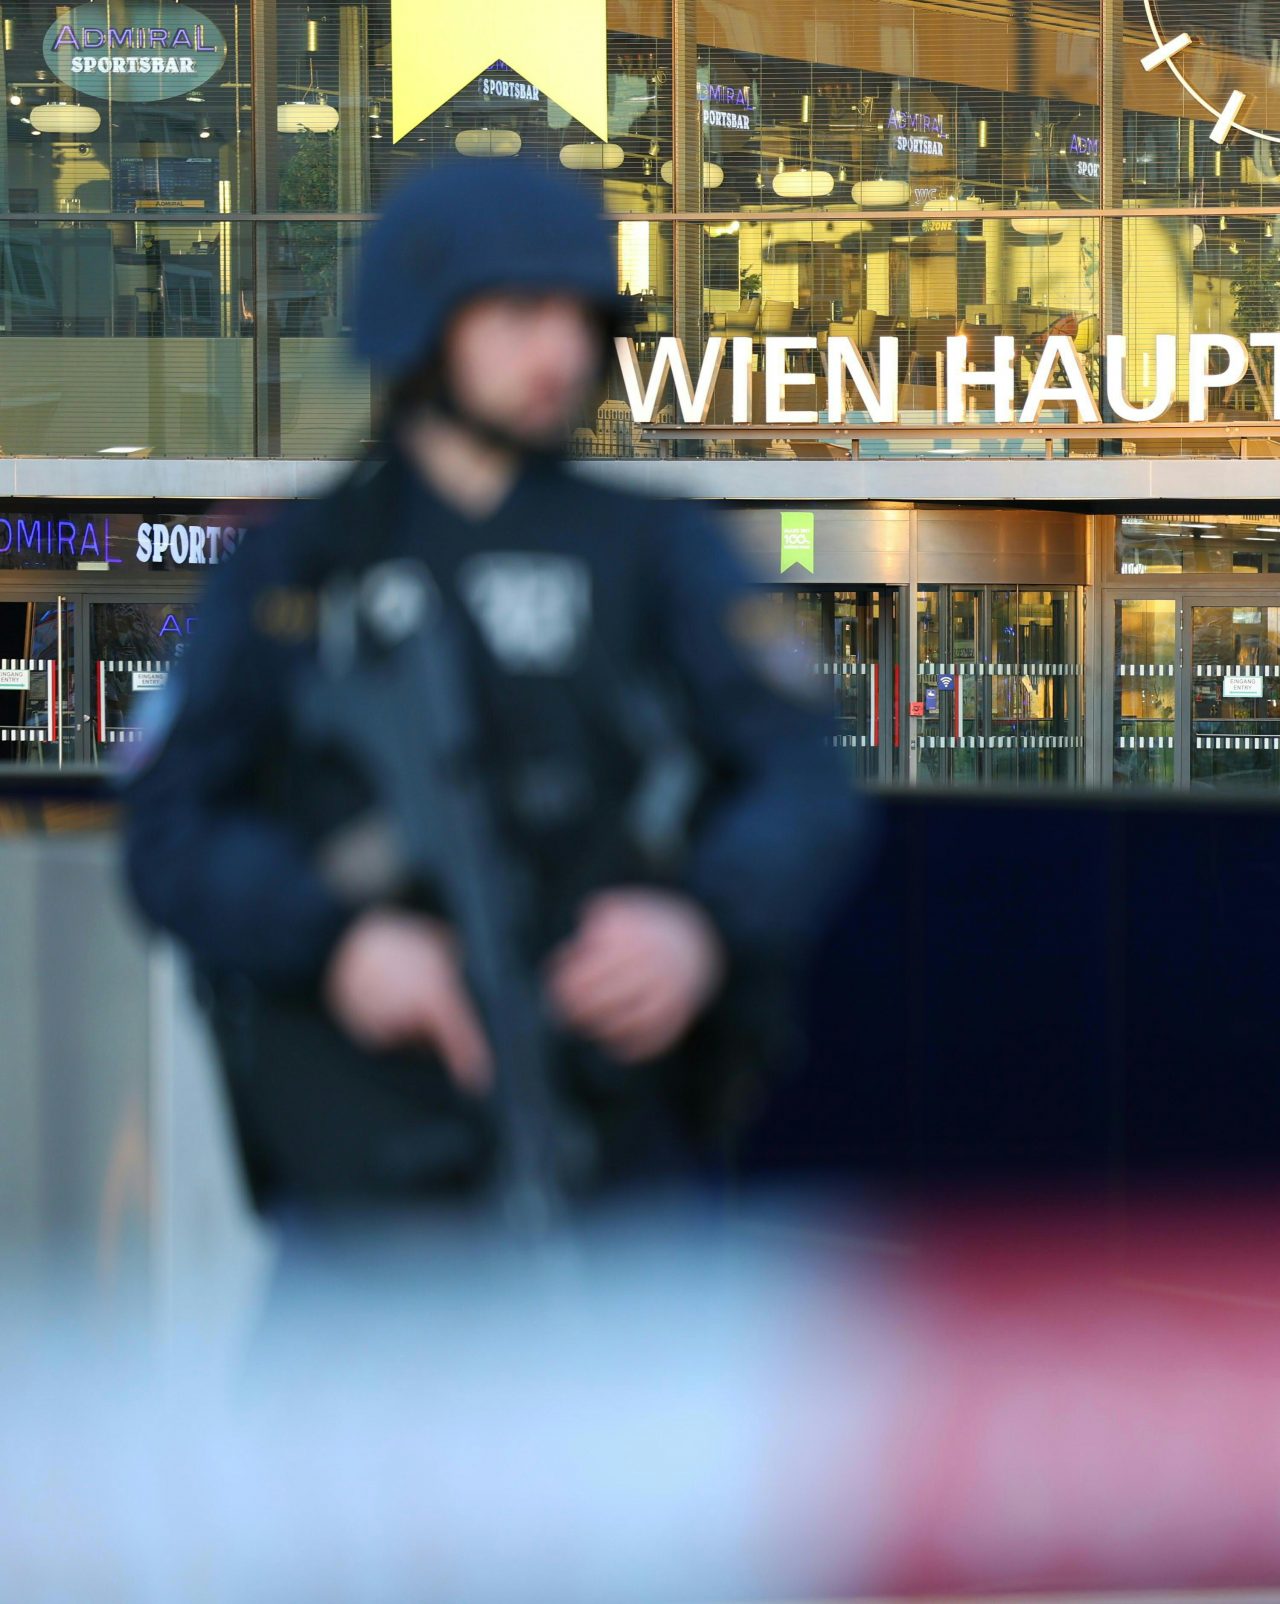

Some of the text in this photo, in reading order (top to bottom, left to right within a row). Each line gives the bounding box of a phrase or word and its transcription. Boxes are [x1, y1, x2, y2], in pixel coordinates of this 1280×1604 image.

[52, 25, 217, 52] ADMIRAL
[71, 56, 196, 73] SPORTSBAR
[483, 78, 539, 101] SPORTSBAR
[697, 83, 756, 110] DMIRAL
[703, 109, 750, 130] PORTSBAR
[887, 107, 949, 139] ADMIRAL
[897, 136, 944, 157] SPORTSBAR
[914, 188, 937, 204] WC
[614, 336, 899, 423] WIEN
[0, 518, 248, 564] DMIRAL SPORTS
